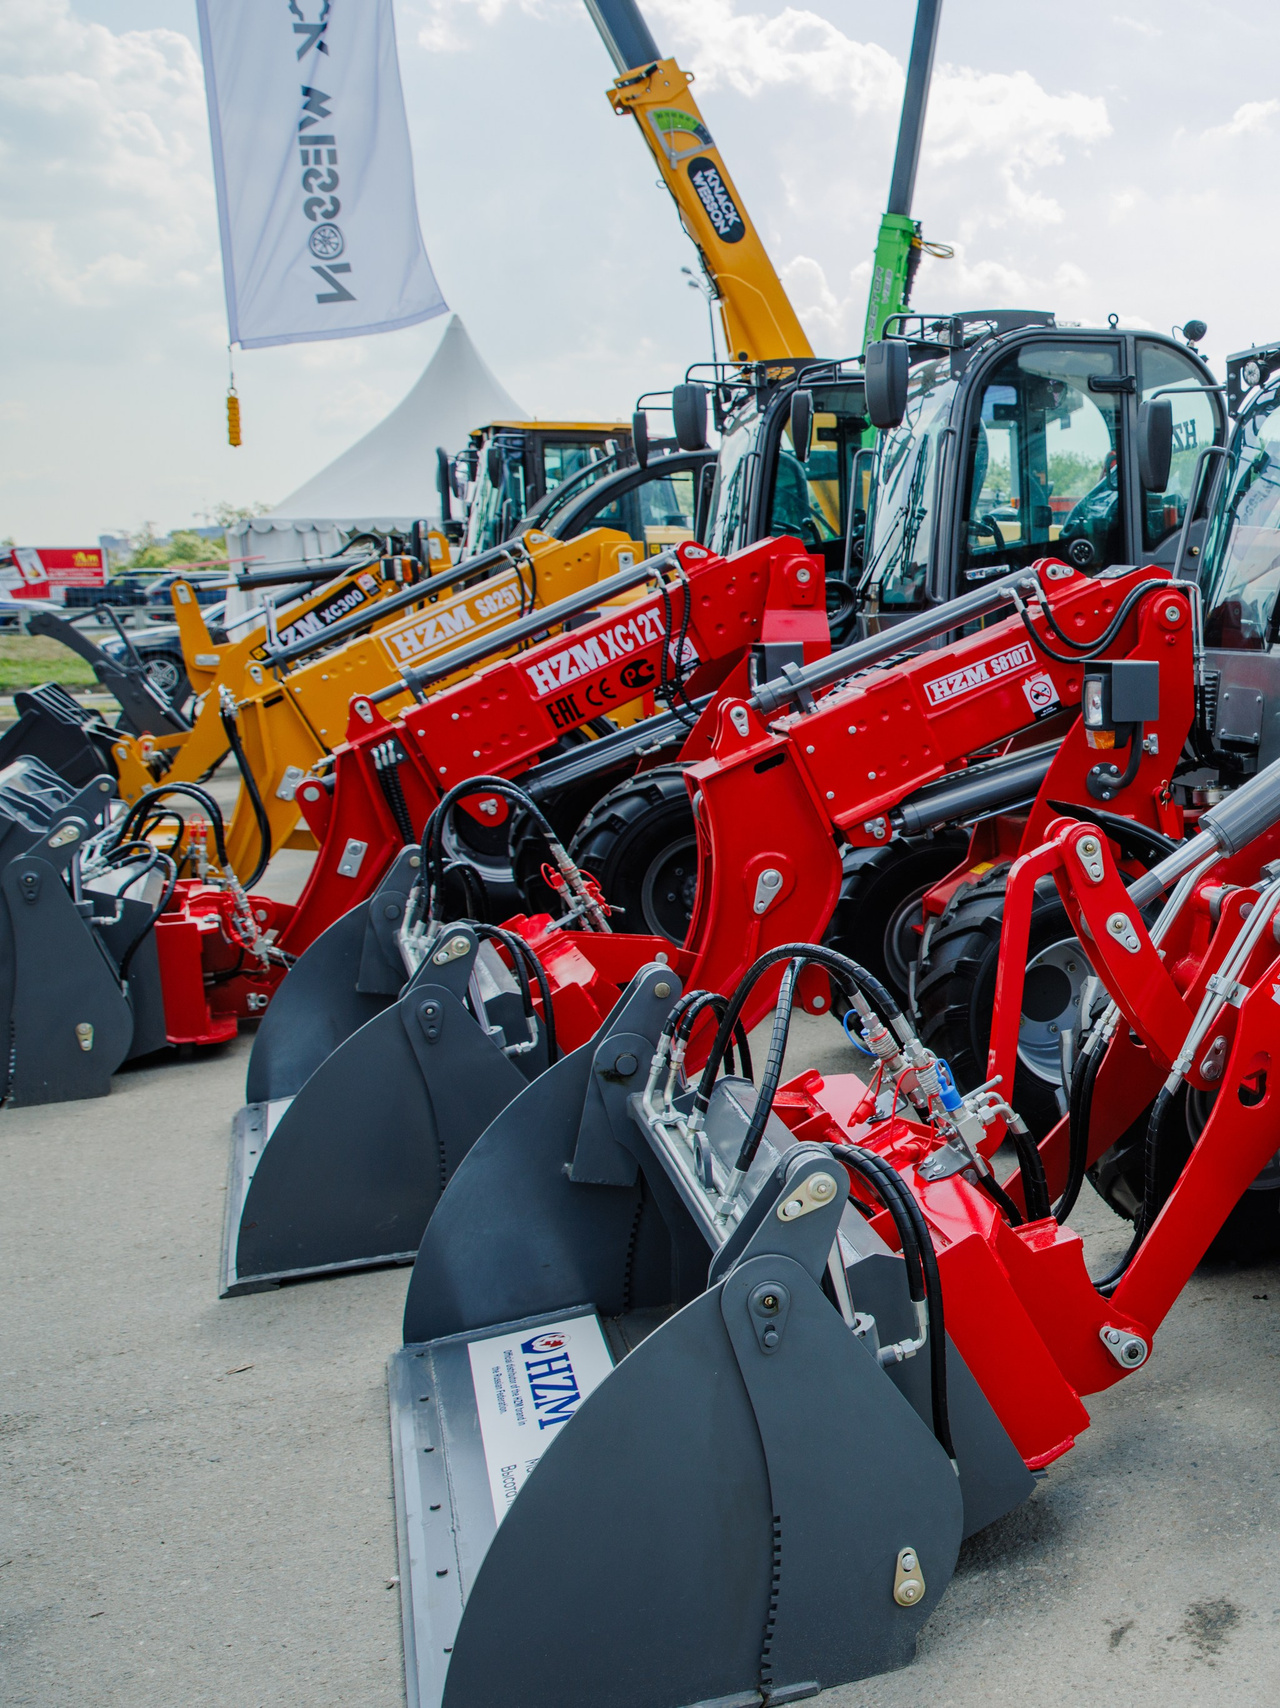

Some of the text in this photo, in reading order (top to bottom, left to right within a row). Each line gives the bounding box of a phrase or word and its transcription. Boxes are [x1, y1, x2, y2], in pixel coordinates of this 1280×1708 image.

[692, 170, 731, 235] WESSON
[703, 168, 741, 226] KNACK
[319, 589, 365, 623] XC300
[391, 582, 522, 659] HZM S825T
[526, 607, 667, 696] HZM XC12T
[930, 647, 1029, 700] HZM S810T
[504, 1349, 515, 1363] Official
[494, 1373, 504, 1389] Russian
[506, 1363, 519, 1384] distributor
[511, 1388, 521, 1397] the
[513, 1396, 524, 1407] HZM
[525, 1352, 581, 1430] HZM
[515, 1407, 527, 1421] brand
[501, 1464, 517, 1498] Высота
